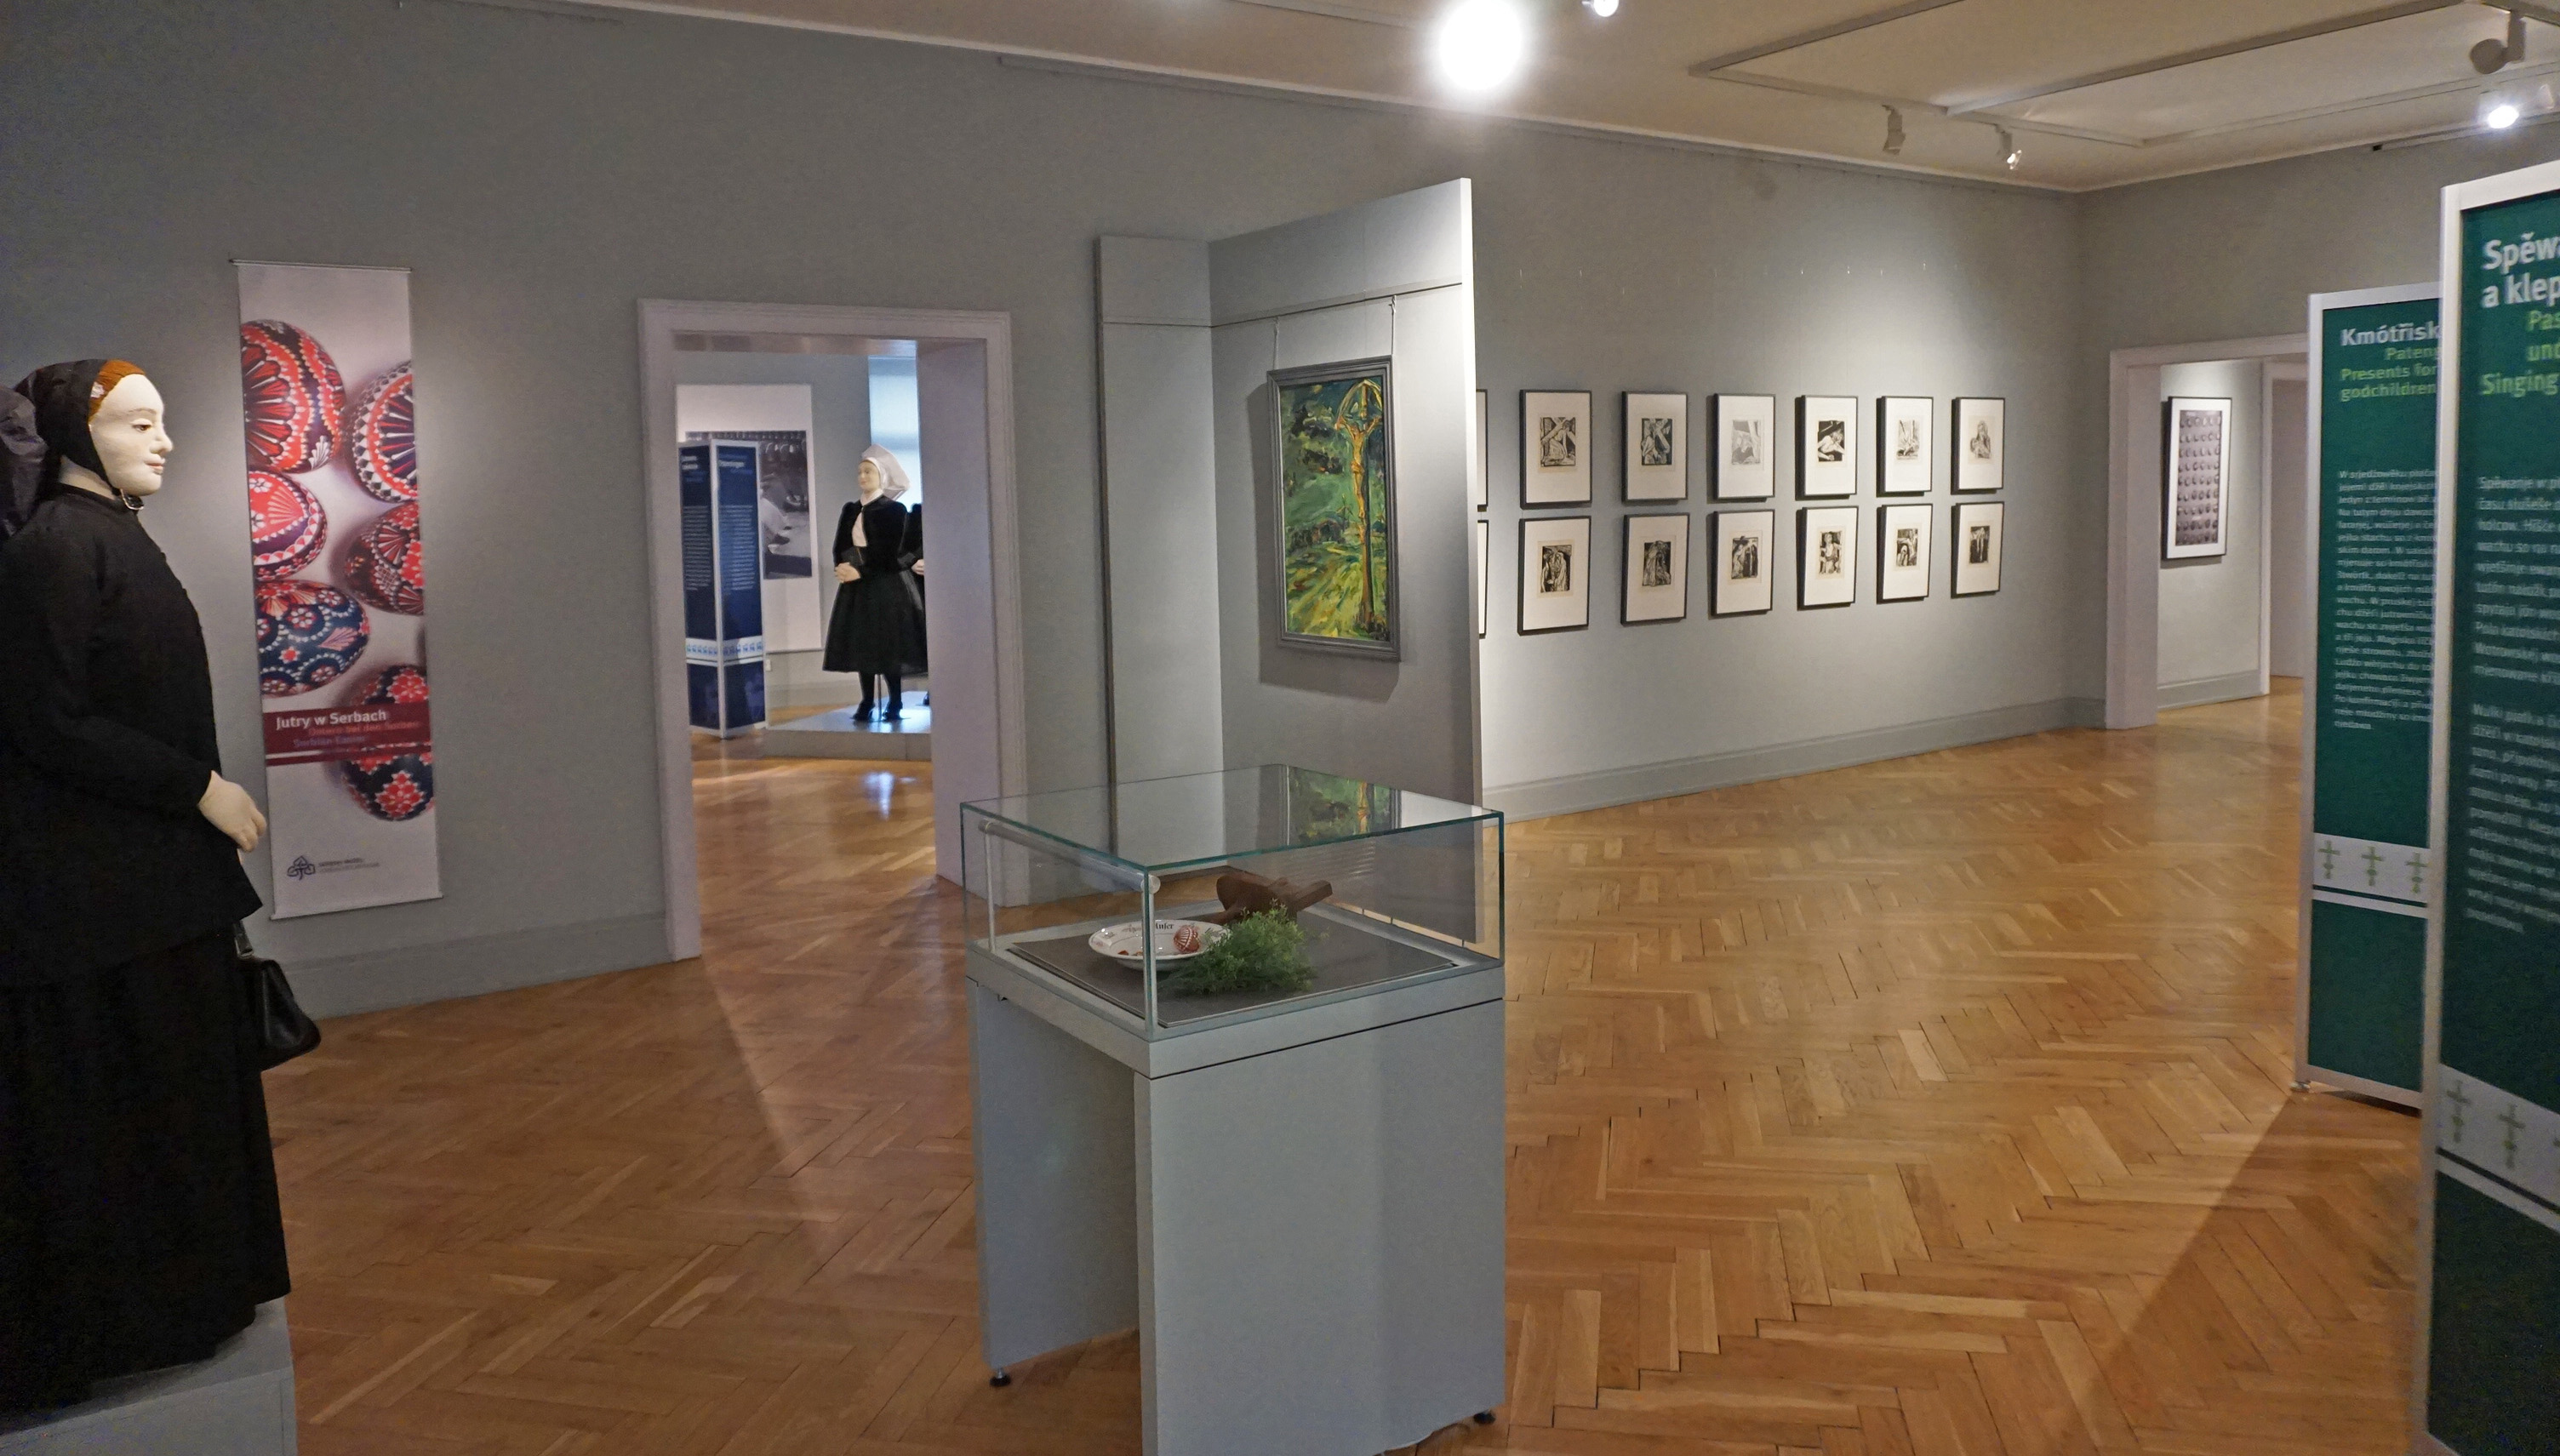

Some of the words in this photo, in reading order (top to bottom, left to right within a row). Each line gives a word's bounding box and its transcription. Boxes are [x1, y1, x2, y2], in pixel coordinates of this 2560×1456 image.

[2482, 285, 2500, 308] a
[2505, 271, 2560, 307] klep
[2385, 347, 2440, 361] Paten
[2340, 366, 2410, 381] Presents
[2481, 369, 2559, 398] Singing
[276, 717, 310, 730] Jutry
[314, 717, 326, 725] w
[329, 710, 387, 724] Serbach
